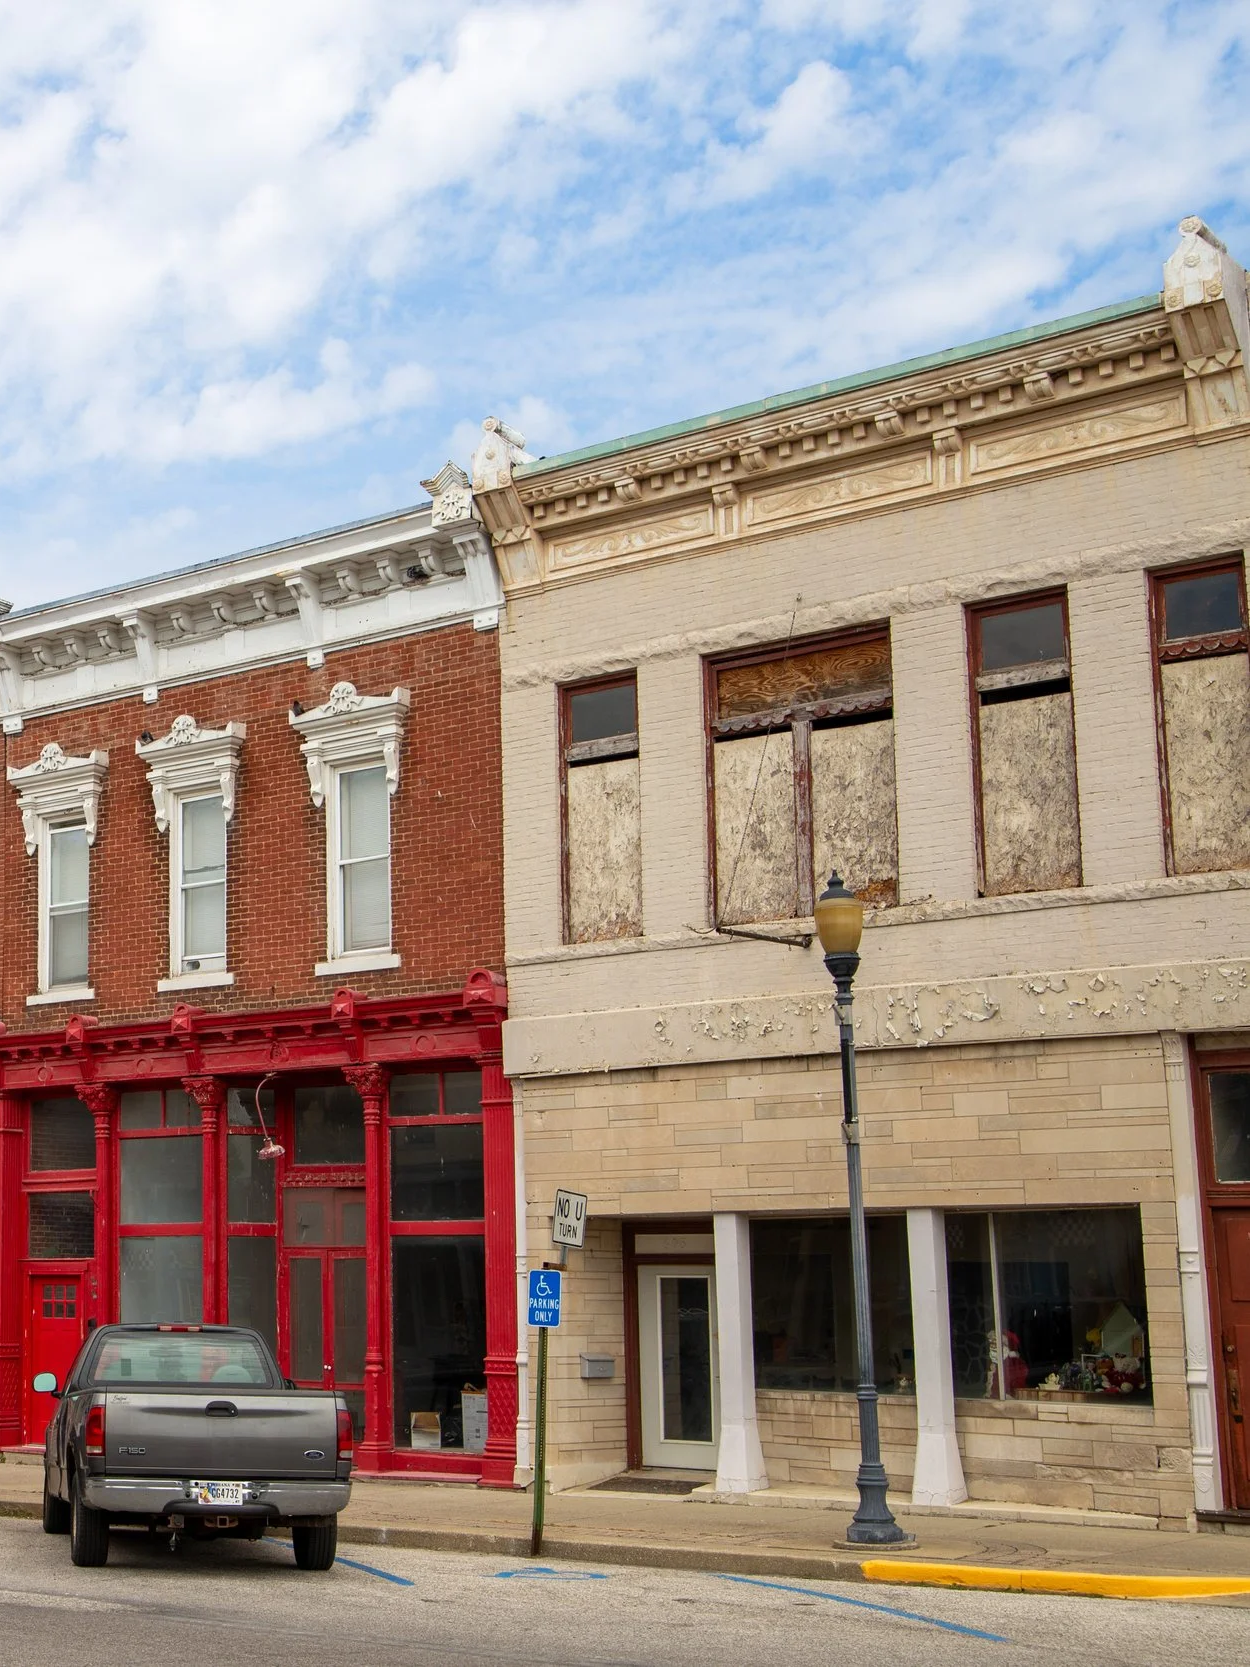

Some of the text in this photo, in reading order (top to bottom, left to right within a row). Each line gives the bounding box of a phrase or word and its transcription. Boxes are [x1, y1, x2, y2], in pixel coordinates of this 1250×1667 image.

[557, 1197, 583, 1221] NO U
[559, 1222, 578, 1239] TURN
[529, 1298, 559, 1310] PARKING
[534, 1311, 553, 1323] ONLY
[211, 1488, 239, 1498] CG4732
